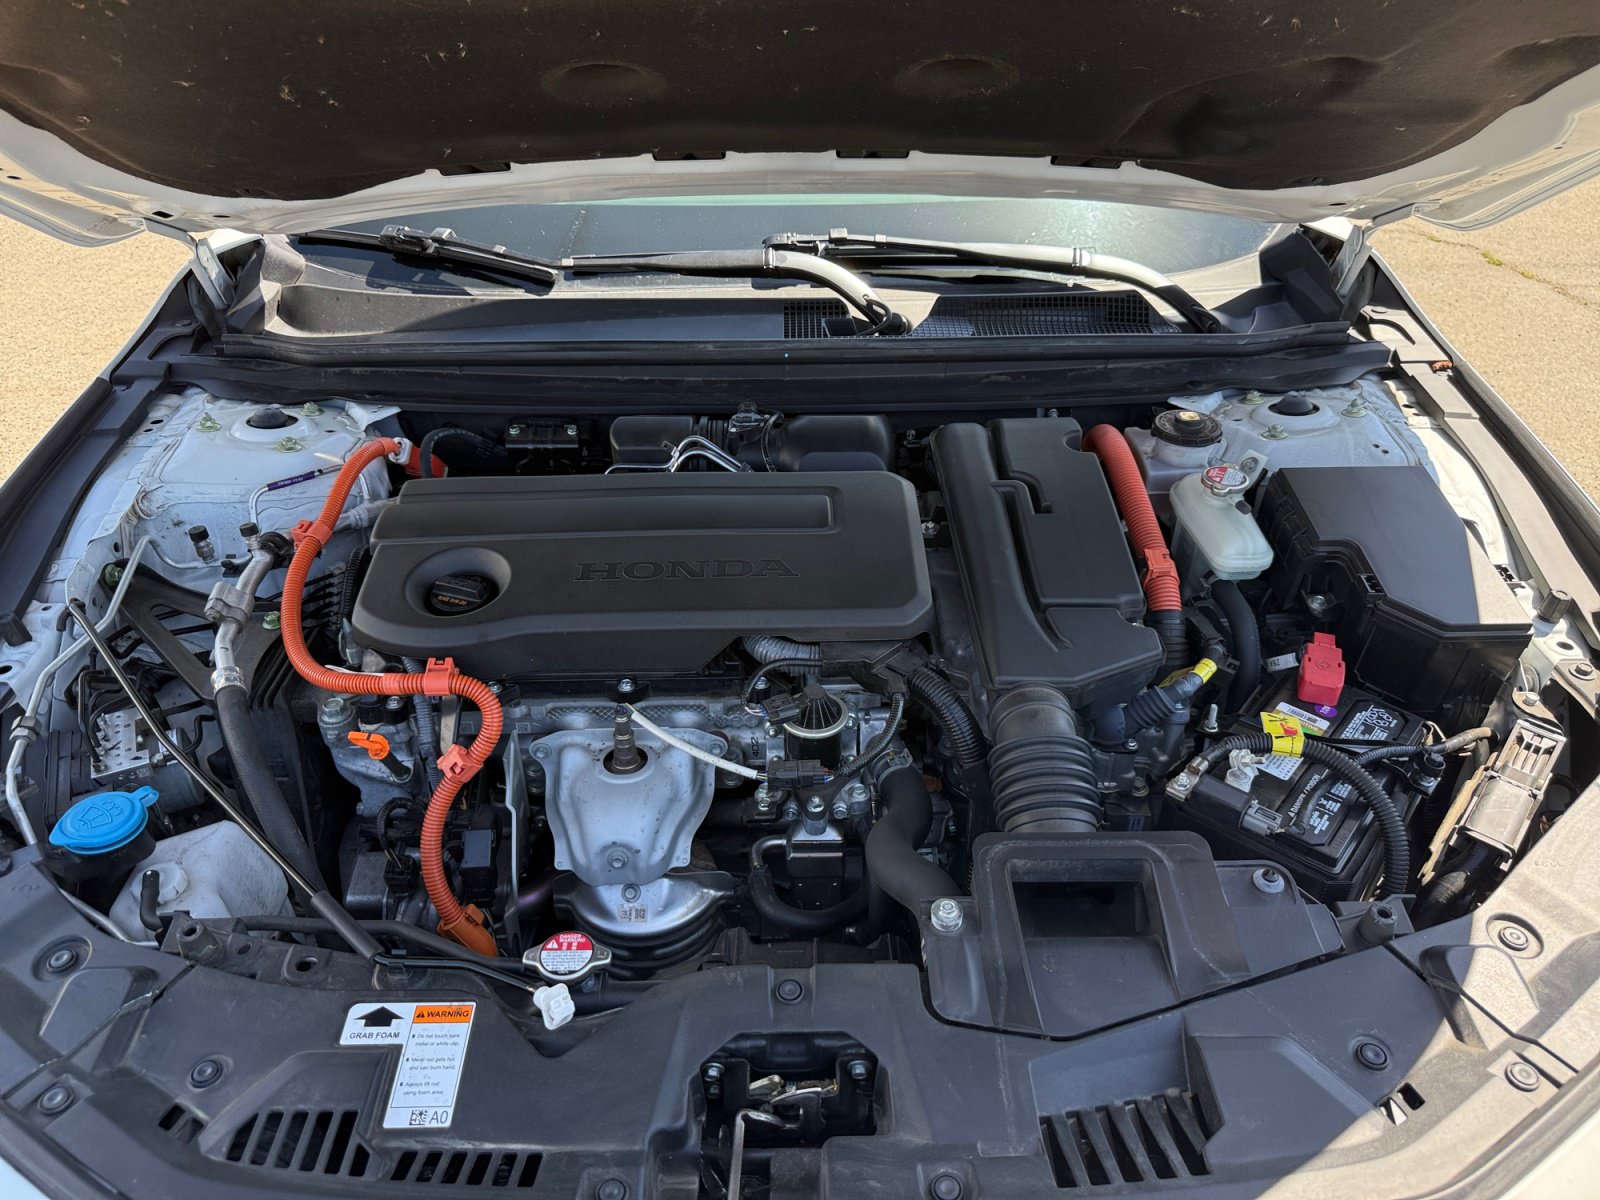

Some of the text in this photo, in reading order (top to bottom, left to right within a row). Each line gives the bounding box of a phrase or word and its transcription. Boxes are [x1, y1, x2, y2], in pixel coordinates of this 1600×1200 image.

[573, 559, 800, 581] HONDA
[427, 1010, 470, 1018] WARNING
[429, 1110, 449, 1124] A0
